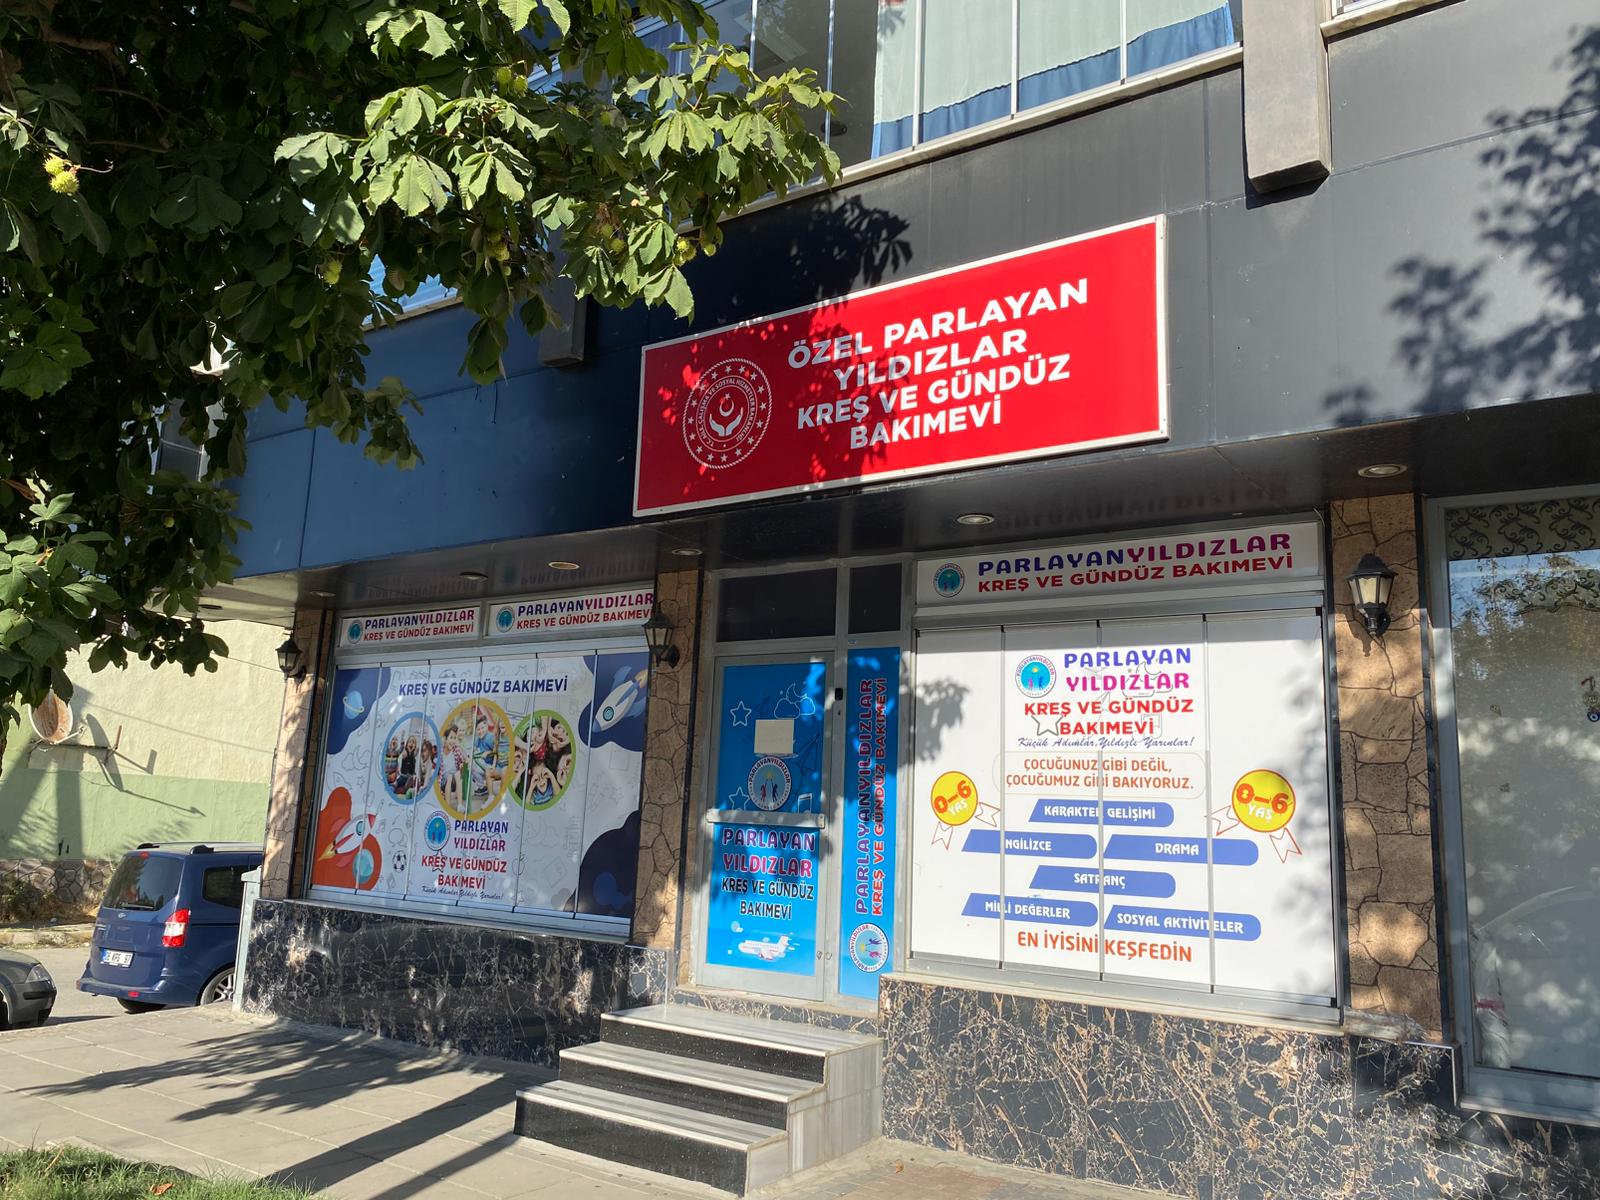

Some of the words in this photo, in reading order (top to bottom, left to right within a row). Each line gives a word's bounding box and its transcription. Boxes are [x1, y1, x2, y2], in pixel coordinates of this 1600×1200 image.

[788, 331, 872, 369] ÖZEL
[884, 278, 1087, 349] PARLAYAN
[834, 329, 1027, 391] YILDIZLAR
[797, 395, 869, 430] KREŞ
[879, 386, 918, 414] VE
[928, 354, 1070, 403] GÜNDÜZ
[851, 394, 1001, 449] BAKIMEVİ
[978, 533, 1291, 576] PARLAYANYILDIZLAR
[978, 577, 1029, 593] KREŞ
[1036, 576, 1063, 588] VE
[1070, 565, 1164, 585] GÜNDÜZ
[1173, 552, 1293, 577] BAKIMEVİ
[365, 609, 475, 629] PARLAYANYILDIZLAR
[517, 619, 541, 629] KREŞ
[544, 618, 556, 626] VE
[559, 612, 600, 625] GÜNDÜZ
[385, 631, 396, 639] VE
[397, 627, 431, 638] GÜNDÜZ
[433, 622, 474, 635] BAKIMEVİ
[1064, 648, 1191, 669] PARLAYAN
[399, 683, 427, 697] KREŞ
[431, 683, 446, 694] VE
[450, 679, 500, 694] GÜNDÜZ
[503, 675, 568, 693] BAKIMEVİ
[1066, 672, 1190, 692] YILDIZLAR
[1024, 702, 1071, 717] KREŞ
[1078, 701, 1102, 714] VE
[1108, 696, 1194, 714] GÜNDÜZ
[874, 677, 887, 759] BAKIMEVİ
[1060, 717, 1154, 735] BAKIMEVİ
[1017, 737, 1049, 748] Küçük
[1142, 737, 1195, 749] Yarınlar!
[1024, 756, 1098, 772] ÇOCUĞUNUZ
[1102, 757, 1128, 771] GİBİ
[1131, 757, 1172, 773] DEĞİL,
[1006, 773, 1080, 787] ÇOCUĞUMUZ
[1113, 776, 1194, 789] BAKIYORUZ.
[855, 679, 873, 914] PARLAYANYILDIZLAR
[872, 763, 886, 836] GÜNDÜZ
[1107, 805, 1156, 822] GELİŞİMİ
[454, 820, 509, 833] PARLAYAN
[454, 837, 506, 851] YILDIZLAR
[722, 828, 816, 851] PARLAYAN
[1004, 838, 1052, 851] NGİLİZCE
[1155, 843, 1199, 855] DRAMA
[873, 841, 884, 864] VE
[421, 855, 446, 868] KREŞ
[449, 857, 461, 869] VE
[464, 856, 507, 873] GÜNDÜZ
[723, 853, 813, 878] YILDIZLAR
[721, 877, 748, 895] KREŞ
[751, 880, 765, 895] VE
[768, 877, 814, 900] GÜNDÜZ
[872, 869, 886, 916] KREŞ
[740, 900, 793, 920] BAKIMEVİ
[1014, 904, 1071, 919] DEĞERLER
[1117, 913, 1160, 927] SOSYAL
[1018, 931, 1039, 947] EN
[1044, 929, 1098, 953] İYİSİNİ
[1105, 939, 1192, 962] KEŞFEDİN
